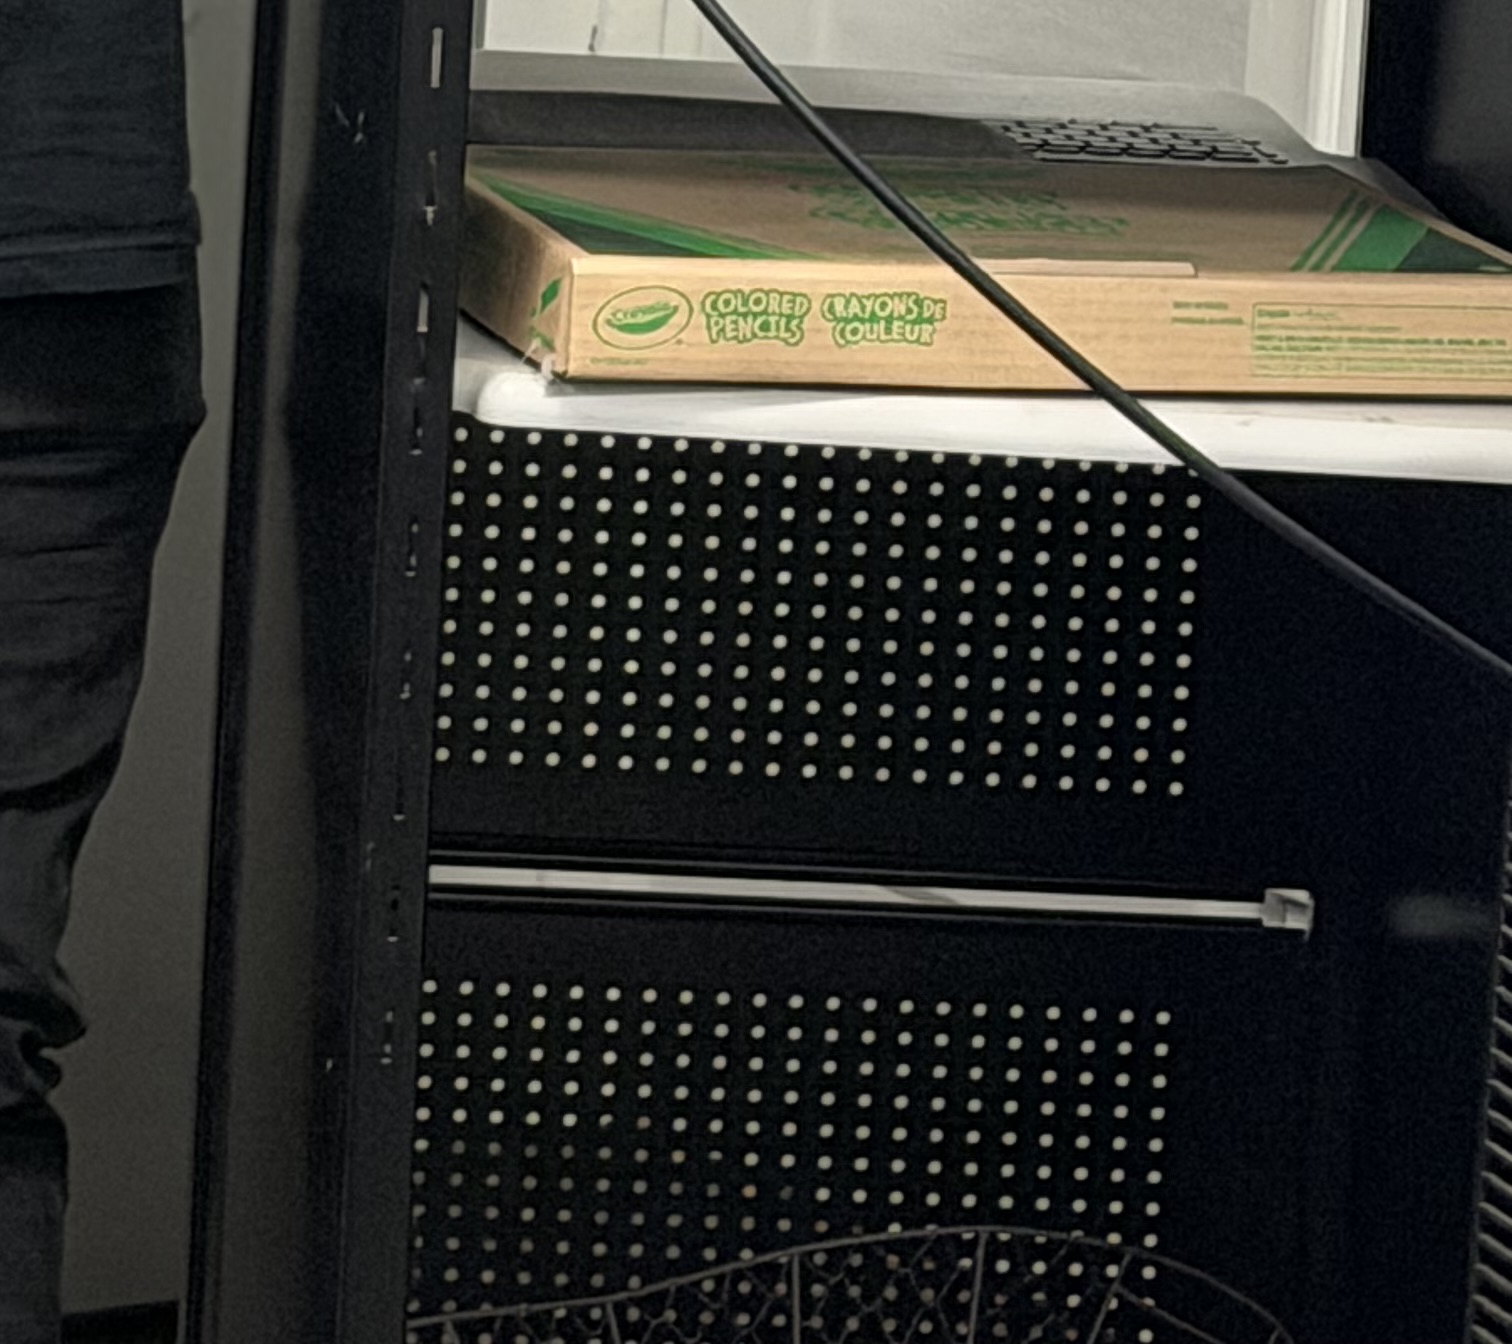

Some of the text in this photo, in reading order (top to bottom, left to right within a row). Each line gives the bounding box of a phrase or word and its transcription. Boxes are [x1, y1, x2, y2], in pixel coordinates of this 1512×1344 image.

[701, 289, 812, 316] COLORED
[822, 292, 948, 322] CRAYONS DE
[705, 314, 805, 346] PENCILS
[832, 319, 937, 347] COULEUR
